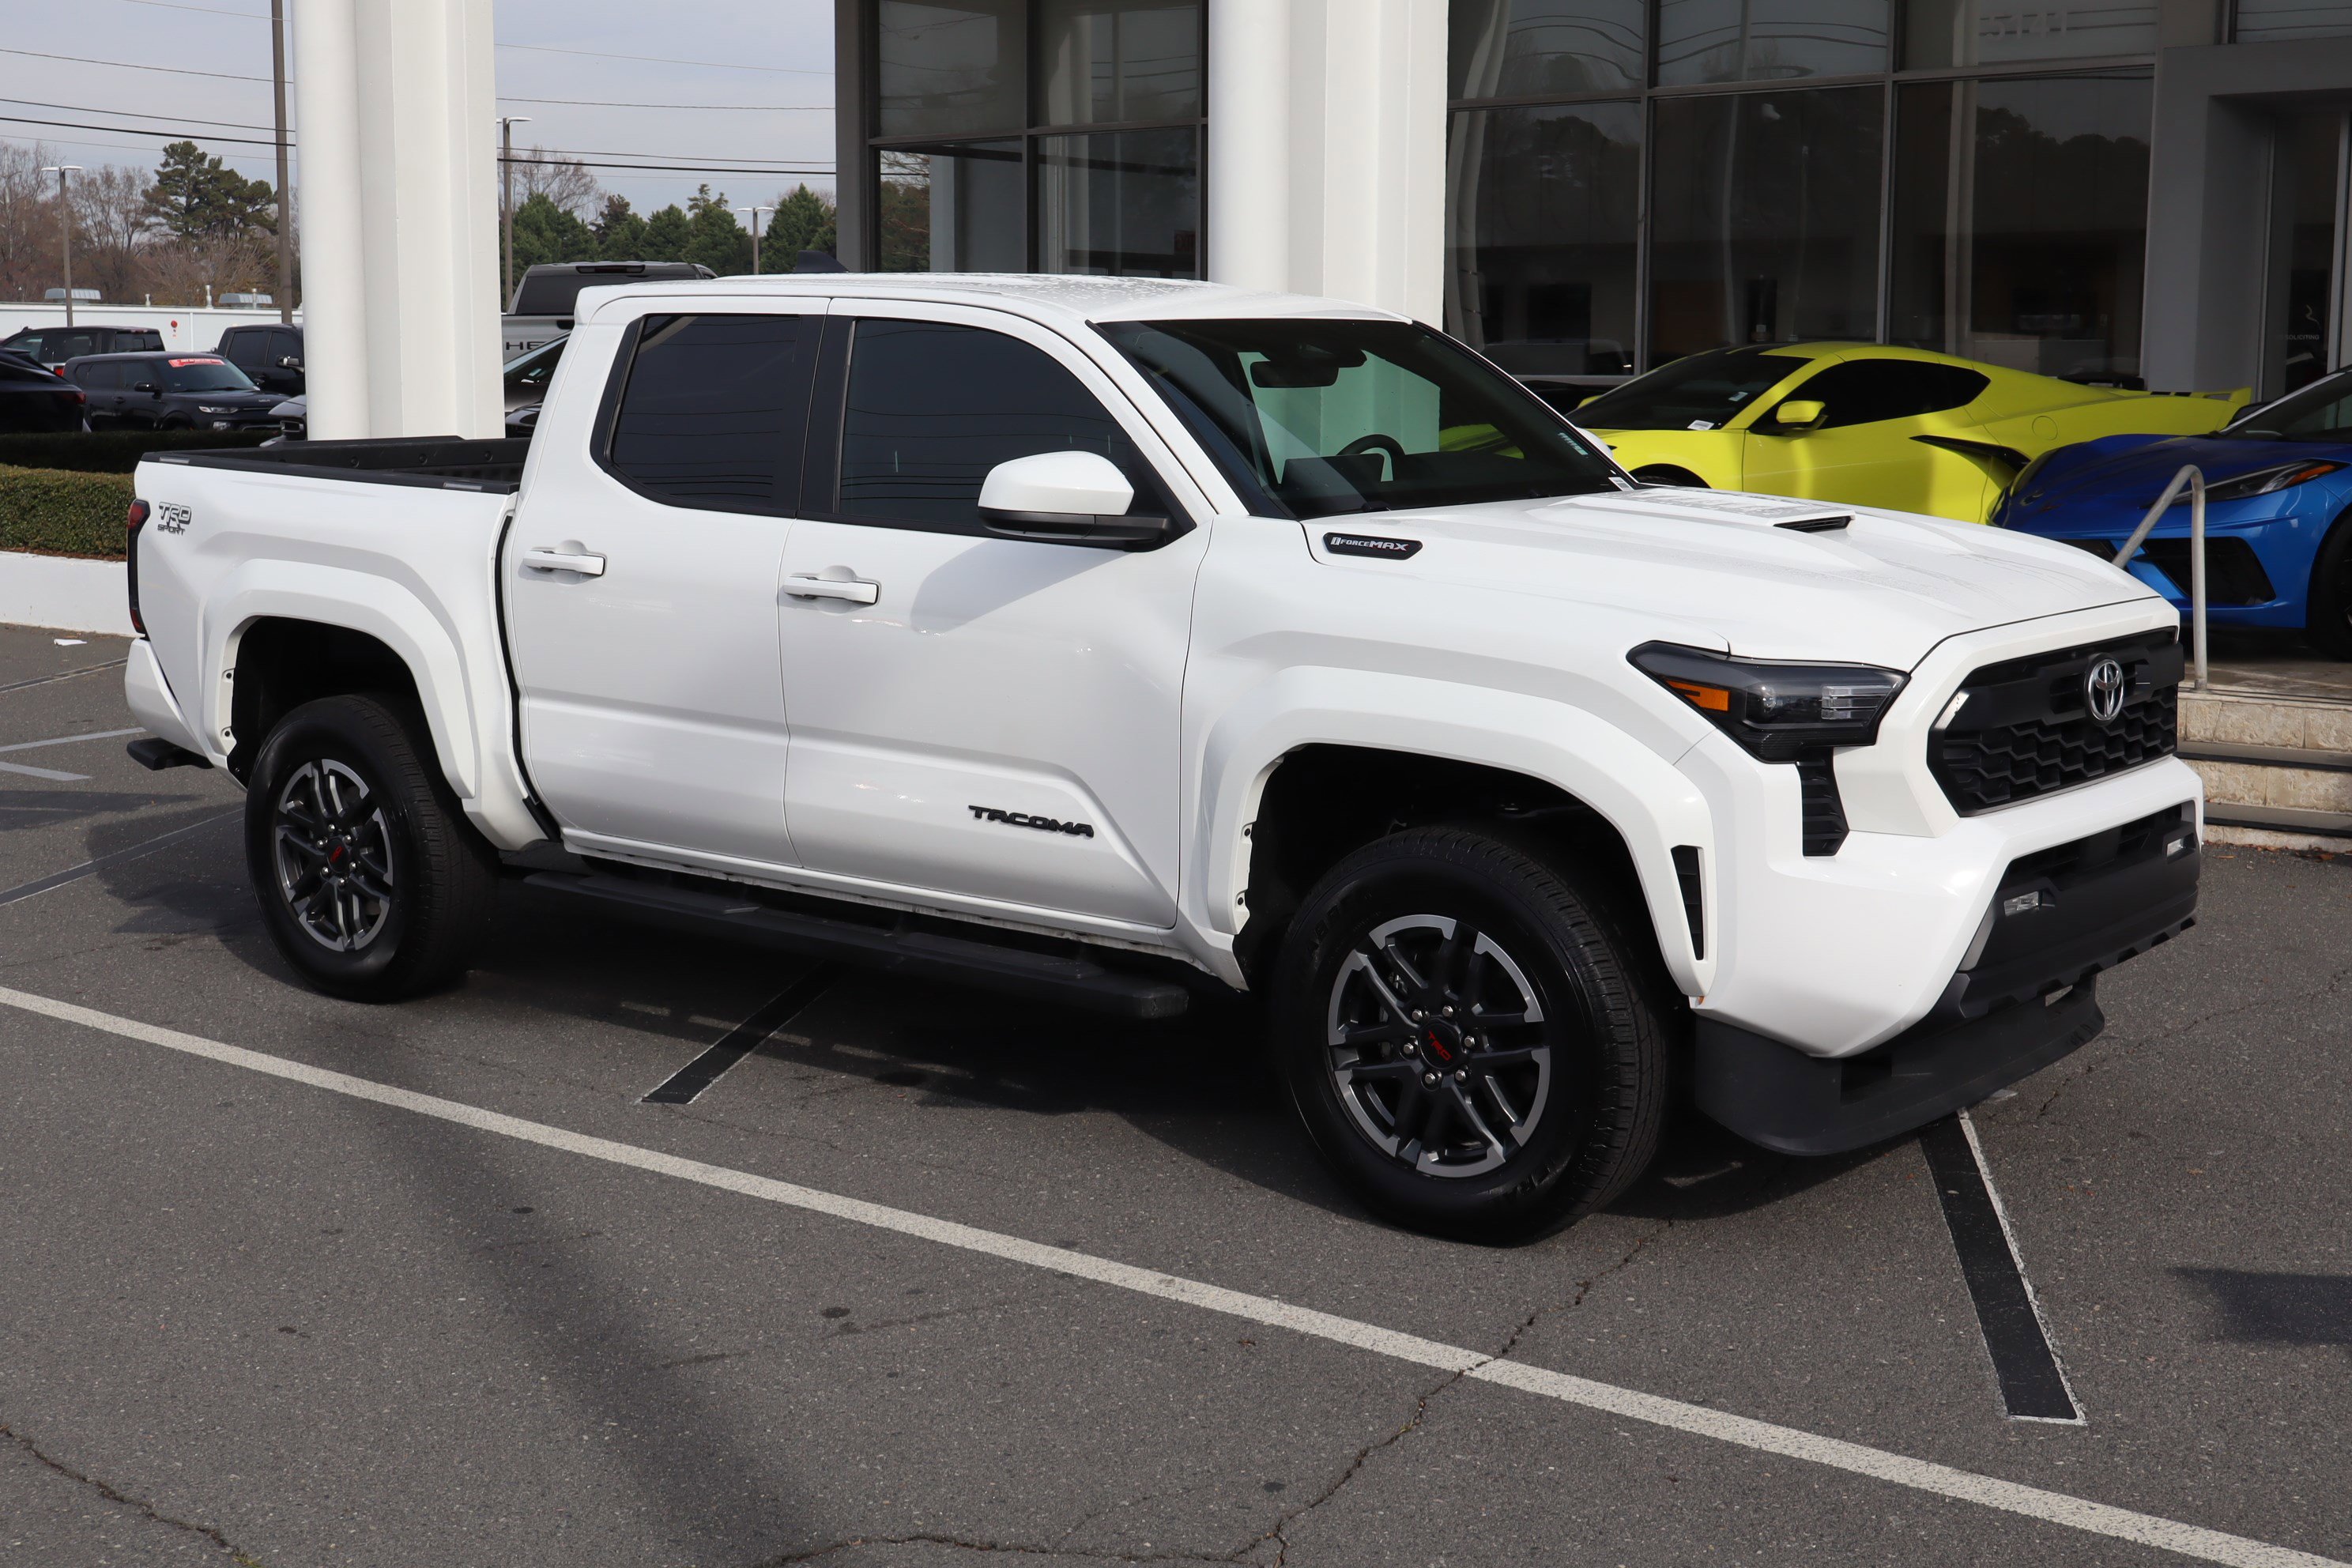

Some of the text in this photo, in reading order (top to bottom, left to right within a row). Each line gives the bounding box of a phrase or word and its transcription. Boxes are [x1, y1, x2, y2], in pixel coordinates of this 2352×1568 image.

[1986, 6, 2067, 40] 5141
[157, 523, 186, 536] SPORT
[159, 502, 191, 528] TRD
[968, 805, 1095, 838] TACOMA
[1428, 1029, 1453, 1061] TRD
